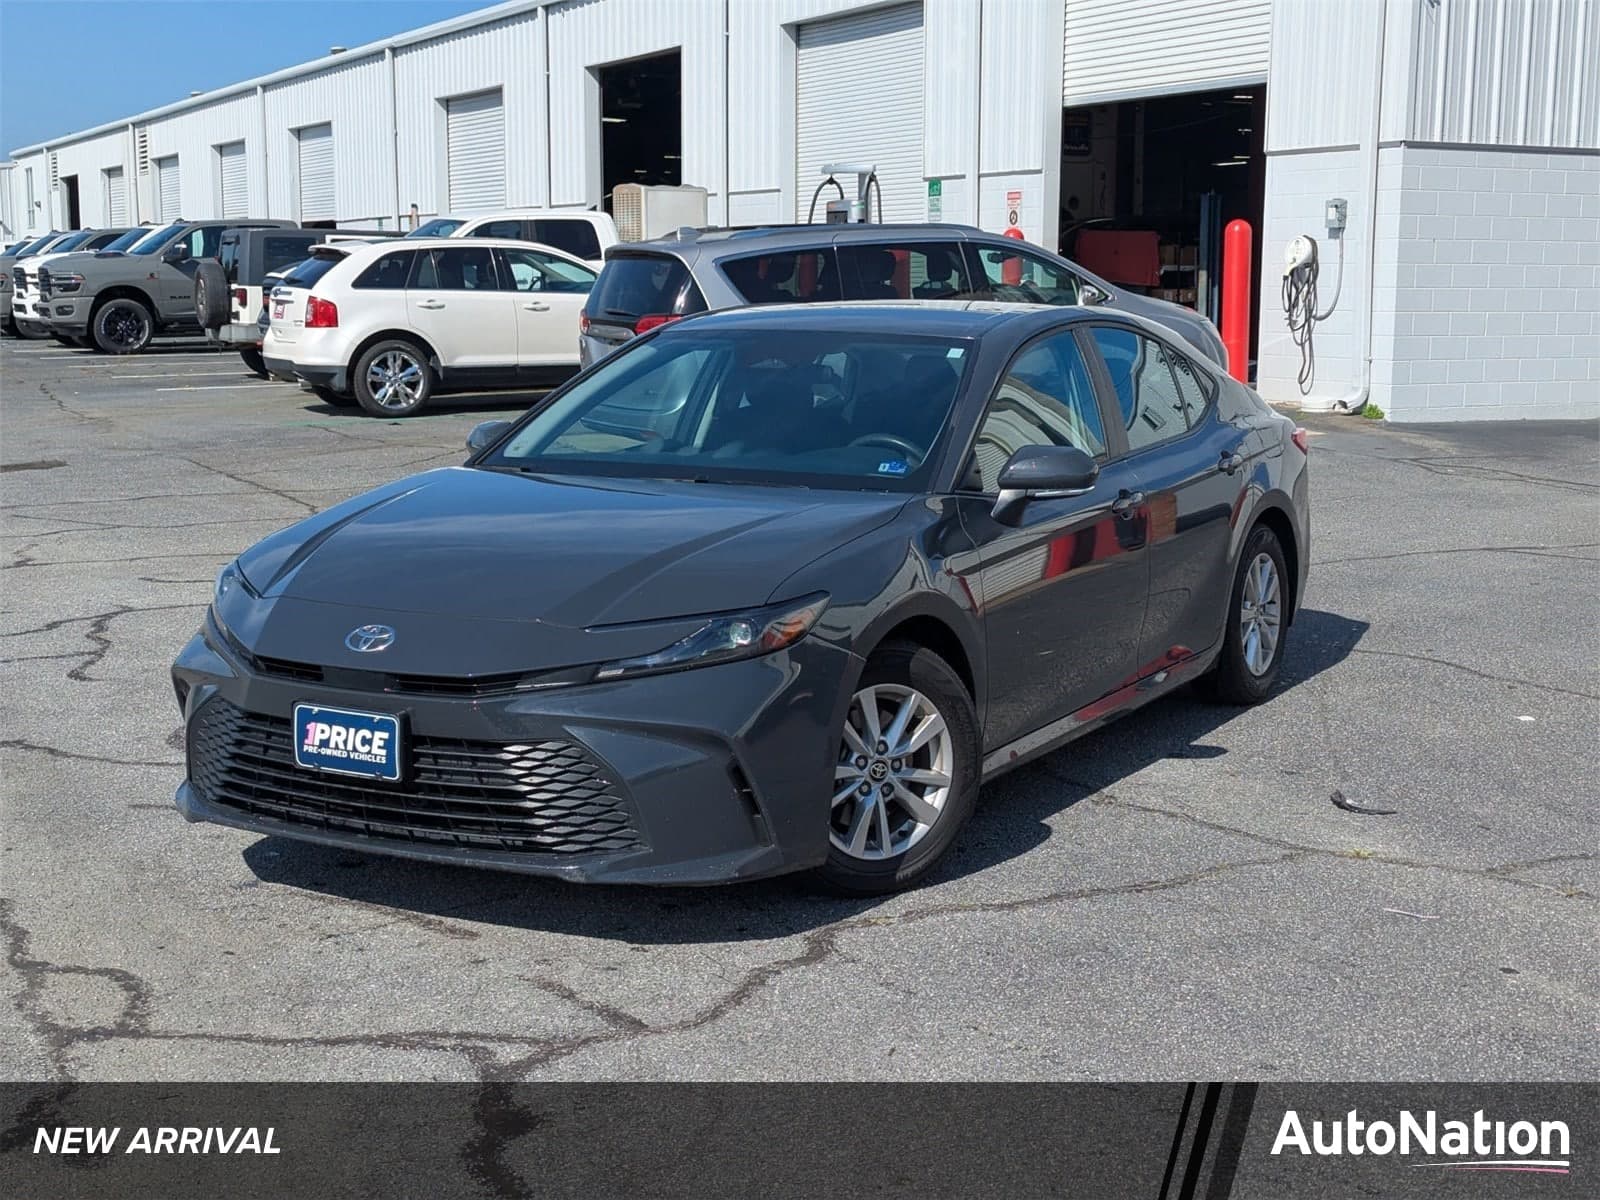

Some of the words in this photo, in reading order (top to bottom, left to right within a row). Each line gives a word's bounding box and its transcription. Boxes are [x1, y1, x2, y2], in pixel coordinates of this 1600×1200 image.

[304, 722, 389, 756] 1PRICE
[303, 745, 347, 758] PRE-OWNED
[349, 751, 387, 764] VEHICLES
